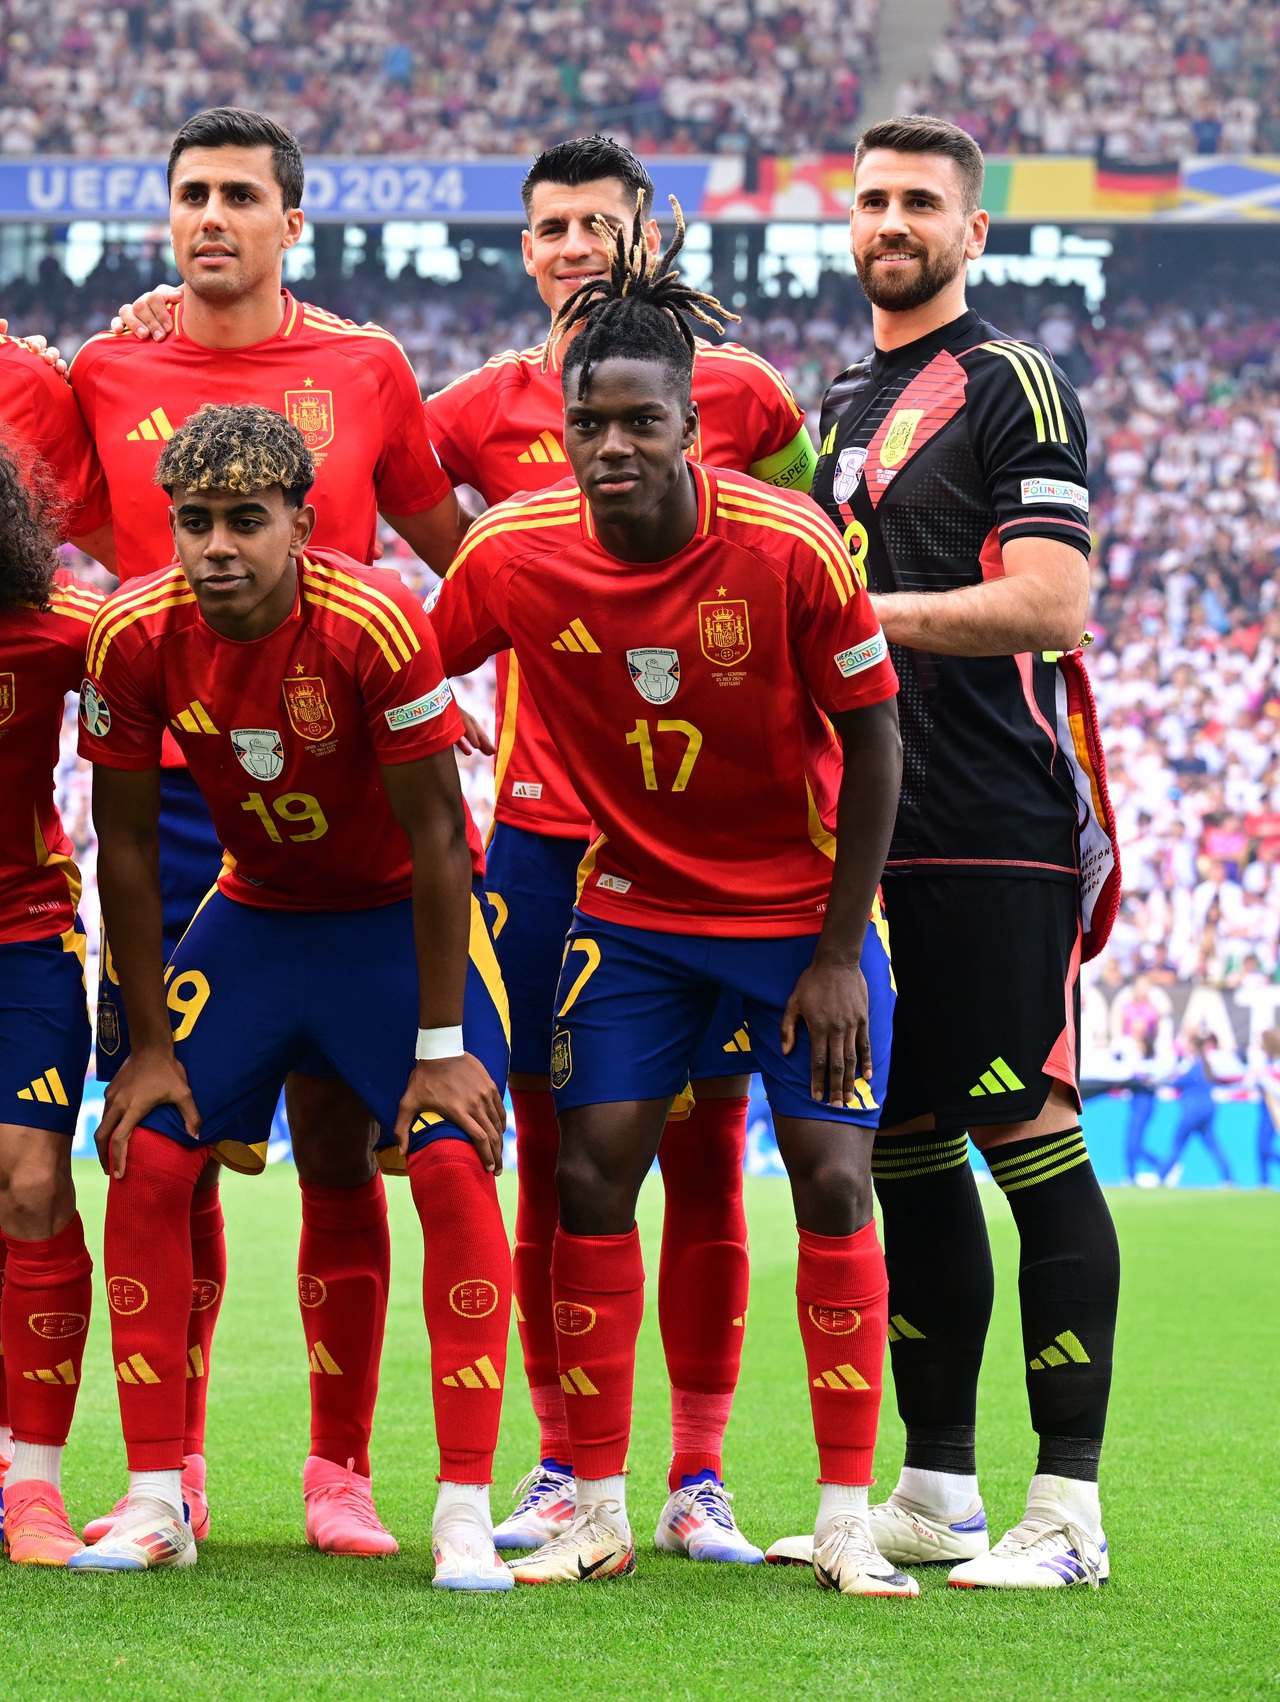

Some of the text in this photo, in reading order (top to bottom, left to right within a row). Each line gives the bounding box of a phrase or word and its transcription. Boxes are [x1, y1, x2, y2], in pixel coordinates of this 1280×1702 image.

[28, 168, 167, 208] UEFA
[341, 168, 467, 208] 2024
[768, 451, 808, 487] ESPECT
[1024, 486, 1087, 503] FOUNDATION
[836, 651, 853, 662] UEFA
[387, 708, 404, 717] UEFA
[389, 685, 449, 724] FOUNDATION
[625, 719, 703, 792] 17
[240, 792, 329, 843] 19
[912, 1522, 934, 1540] COPA
